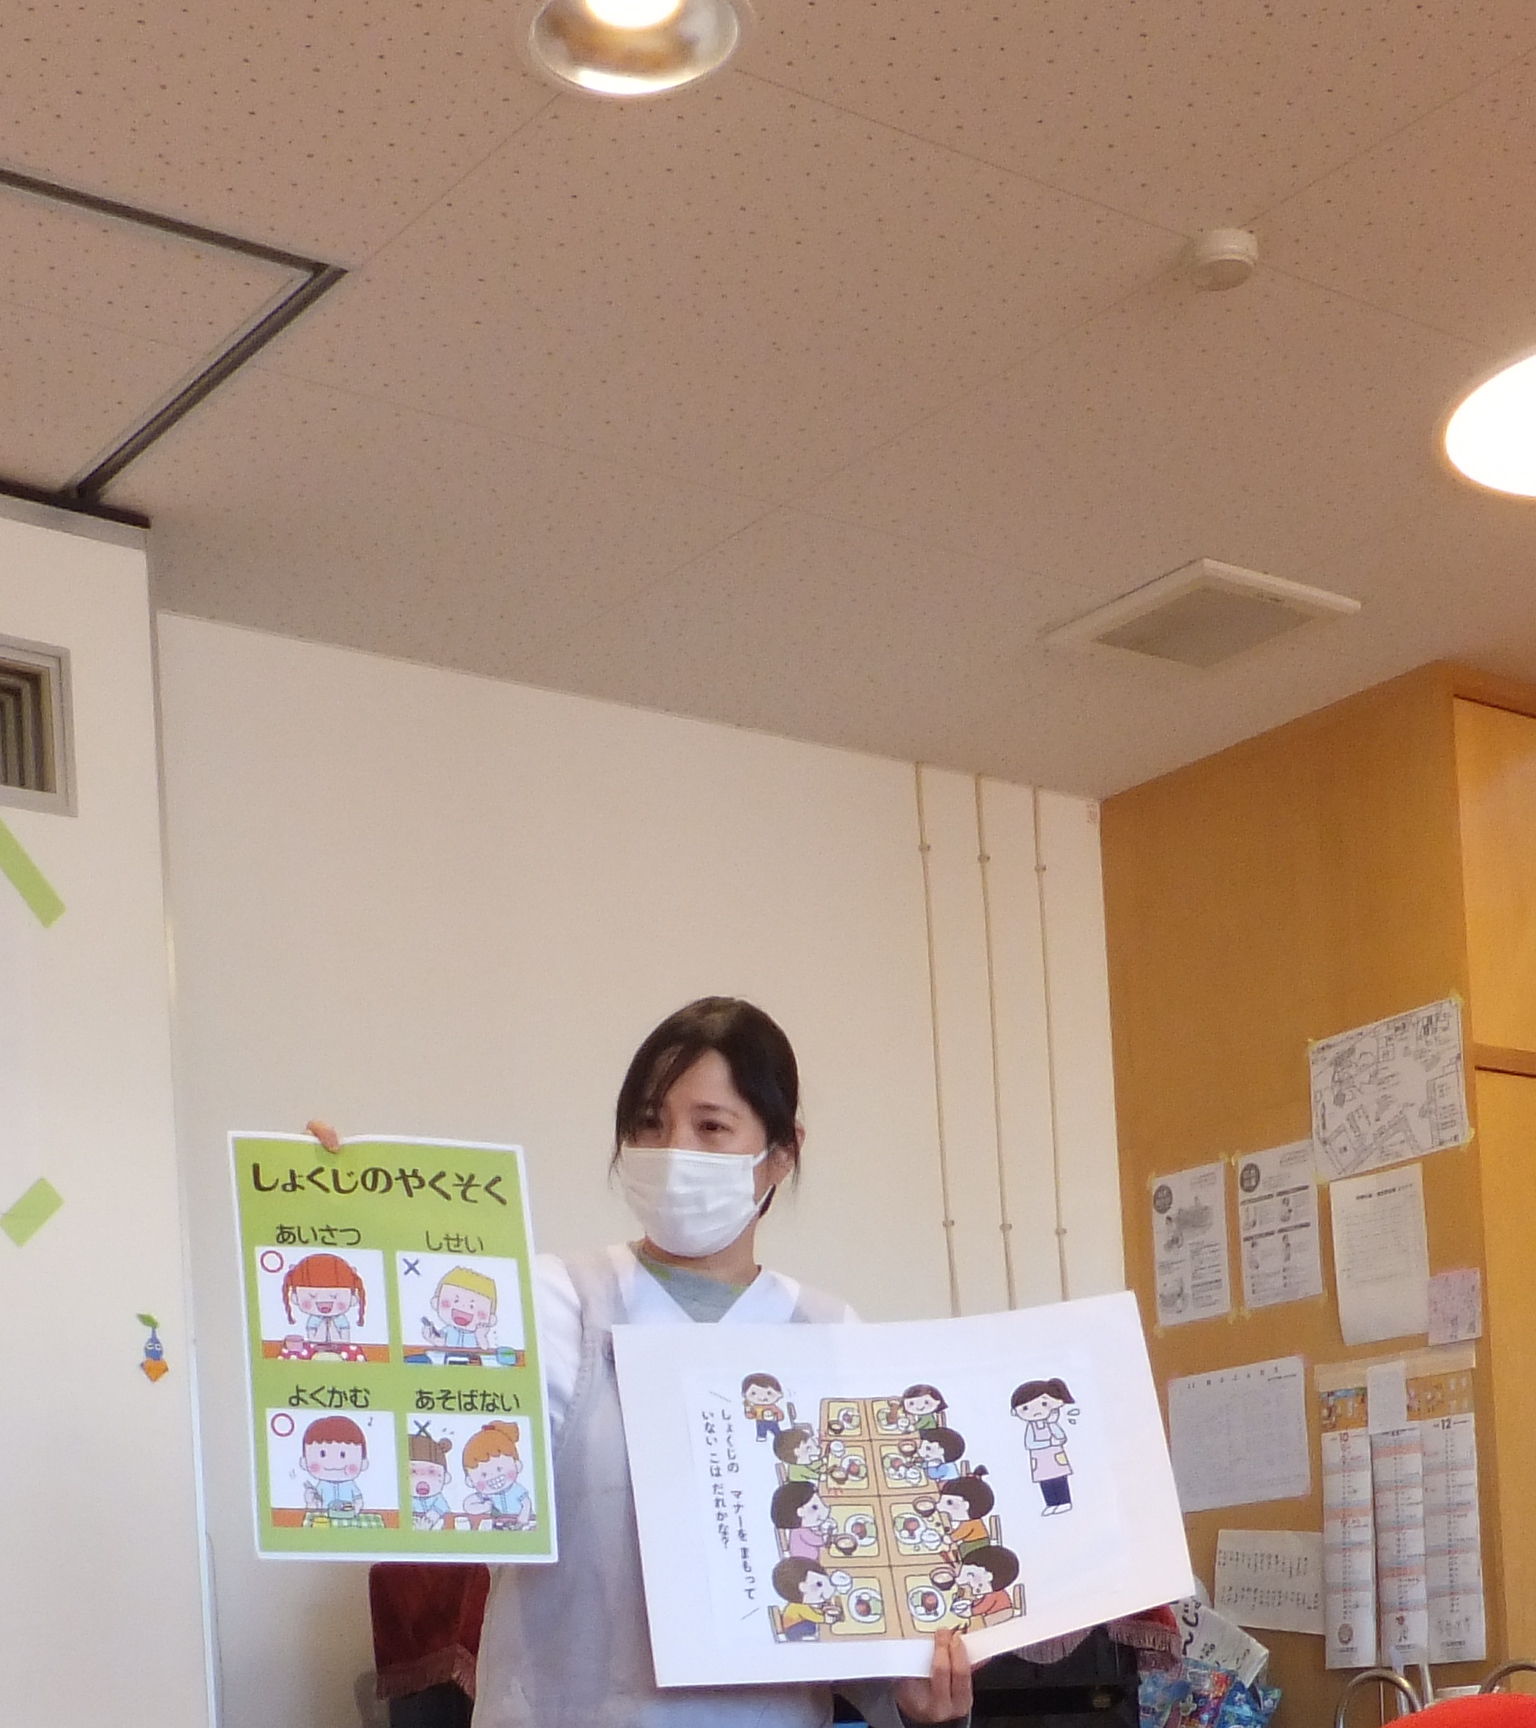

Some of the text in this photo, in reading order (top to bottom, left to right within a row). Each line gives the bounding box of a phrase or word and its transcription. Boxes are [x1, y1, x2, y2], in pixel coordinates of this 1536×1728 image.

[251, 1162, 509, 1205] しょくじのやくそく
[276, 1224, 362, 1246] あいさつ
[425, 1231, 484, 1253] しせい
[288, 1385, 371, 1408] よくかむ
[415, 1389, 520, 1412] あそばない
[1440, 1418, 1452, 1430] 12
[722, 1409, 739, 1473] しょくじの
